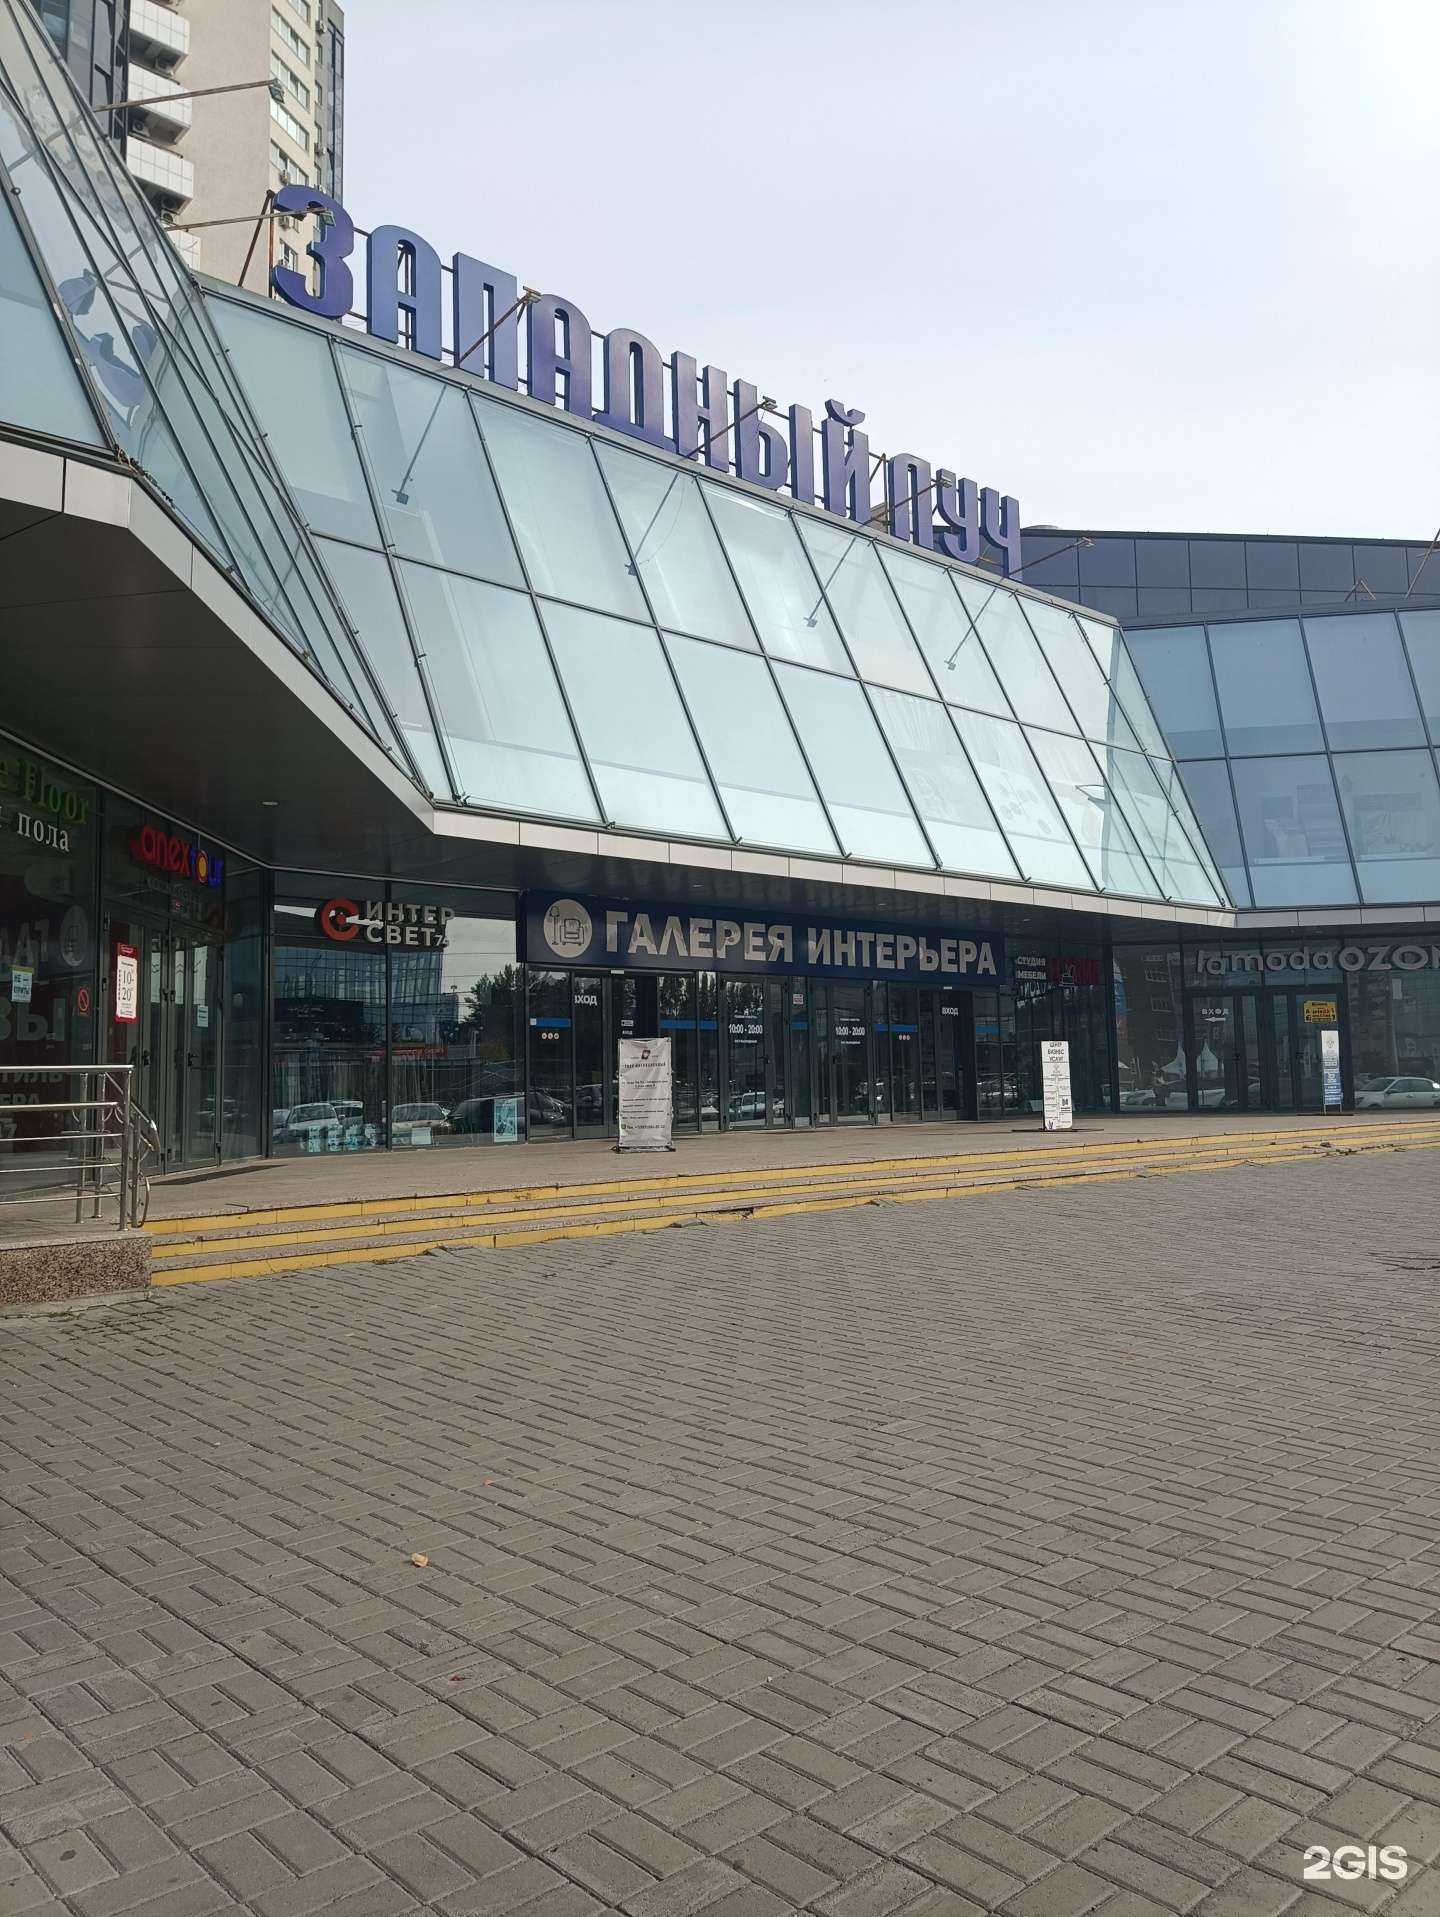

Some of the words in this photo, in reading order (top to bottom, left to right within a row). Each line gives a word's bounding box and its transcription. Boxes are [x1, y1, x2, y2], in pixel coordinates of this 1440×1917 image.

[272, 184, 871, 525] ЗАПАДНЫЙ
[887, 452, 1024, 582] ЛУЧ
[17, 812, 70, 852] пола
[365, 900, 455, 925] ИНТЕР
[606, 910, 793, 963] ГАЛЕРЕЯ
[807, 926, 998, 976] ИНТЕРЬЕРА
[1197, 948, 1334, 975] lamoda
[941, 1006, 959, 1017] ВХОД
[1201, 1007, 1230, 1017] ВХОД
